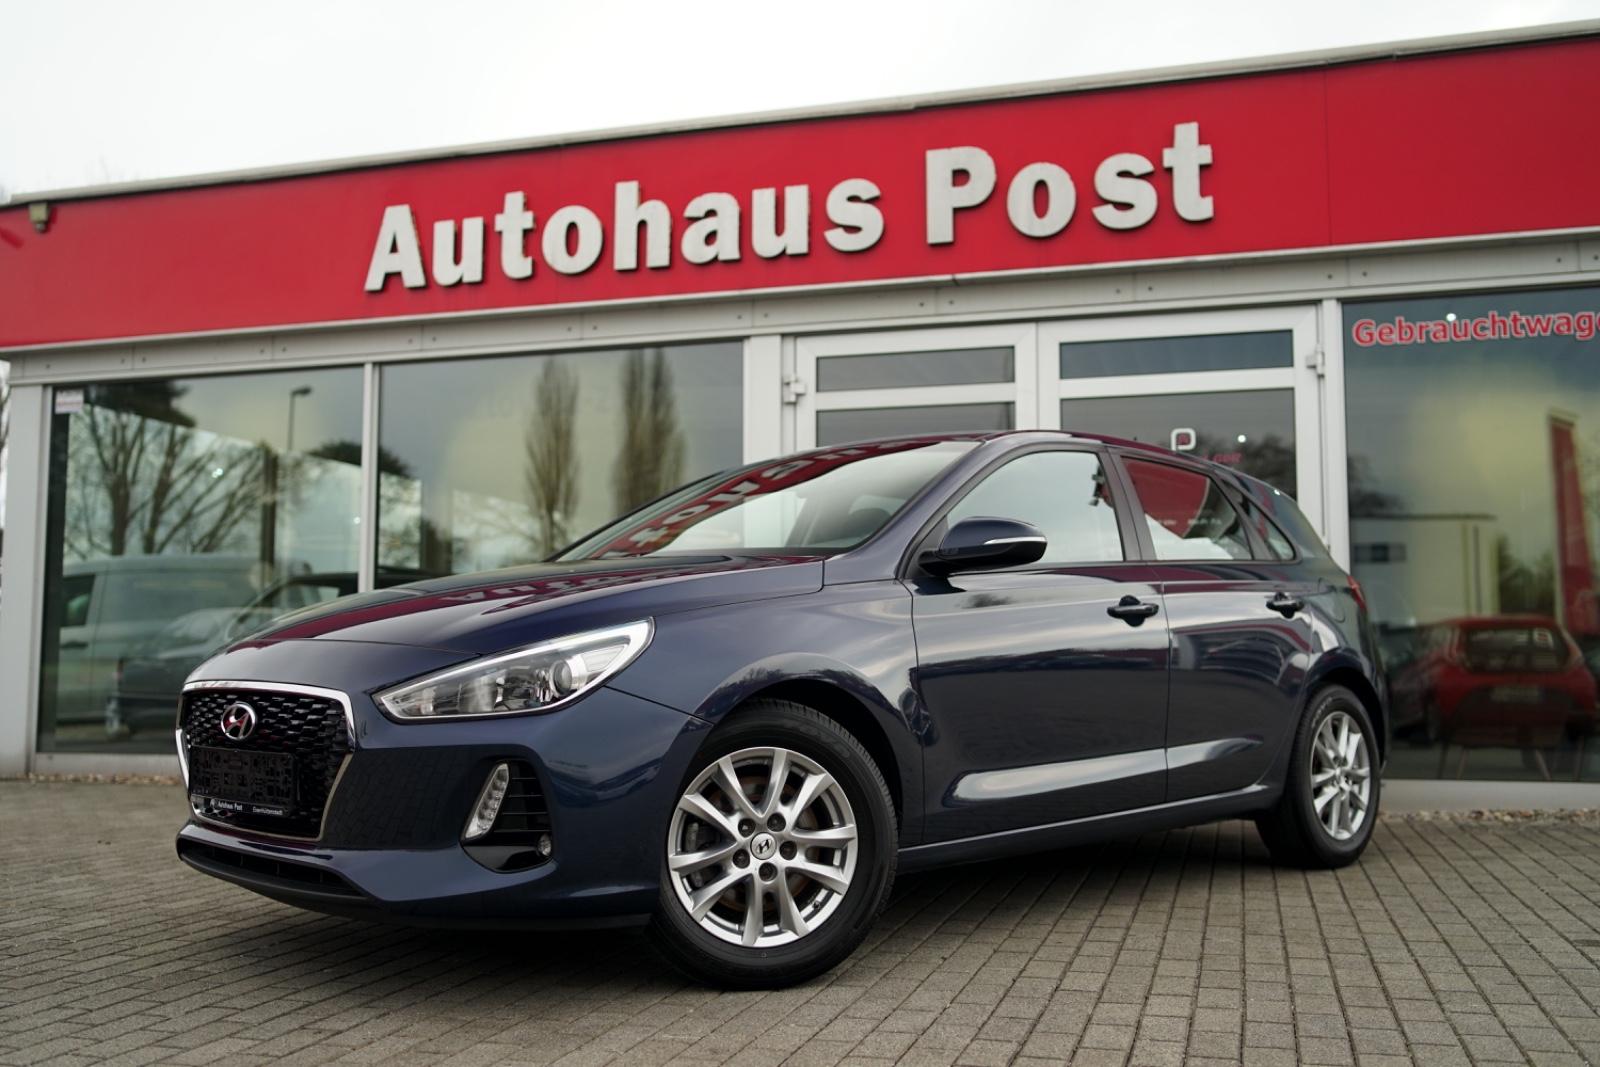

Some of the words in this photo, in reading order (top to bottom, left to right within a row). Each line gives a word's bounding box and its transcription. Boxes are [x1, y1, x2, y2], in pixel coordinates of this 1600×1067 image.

[364, 178, 885, 292] Autohaus
[925, 121, 1215, 246] Post
[1352, 310, 1600, 346] Gebrauchtwag
